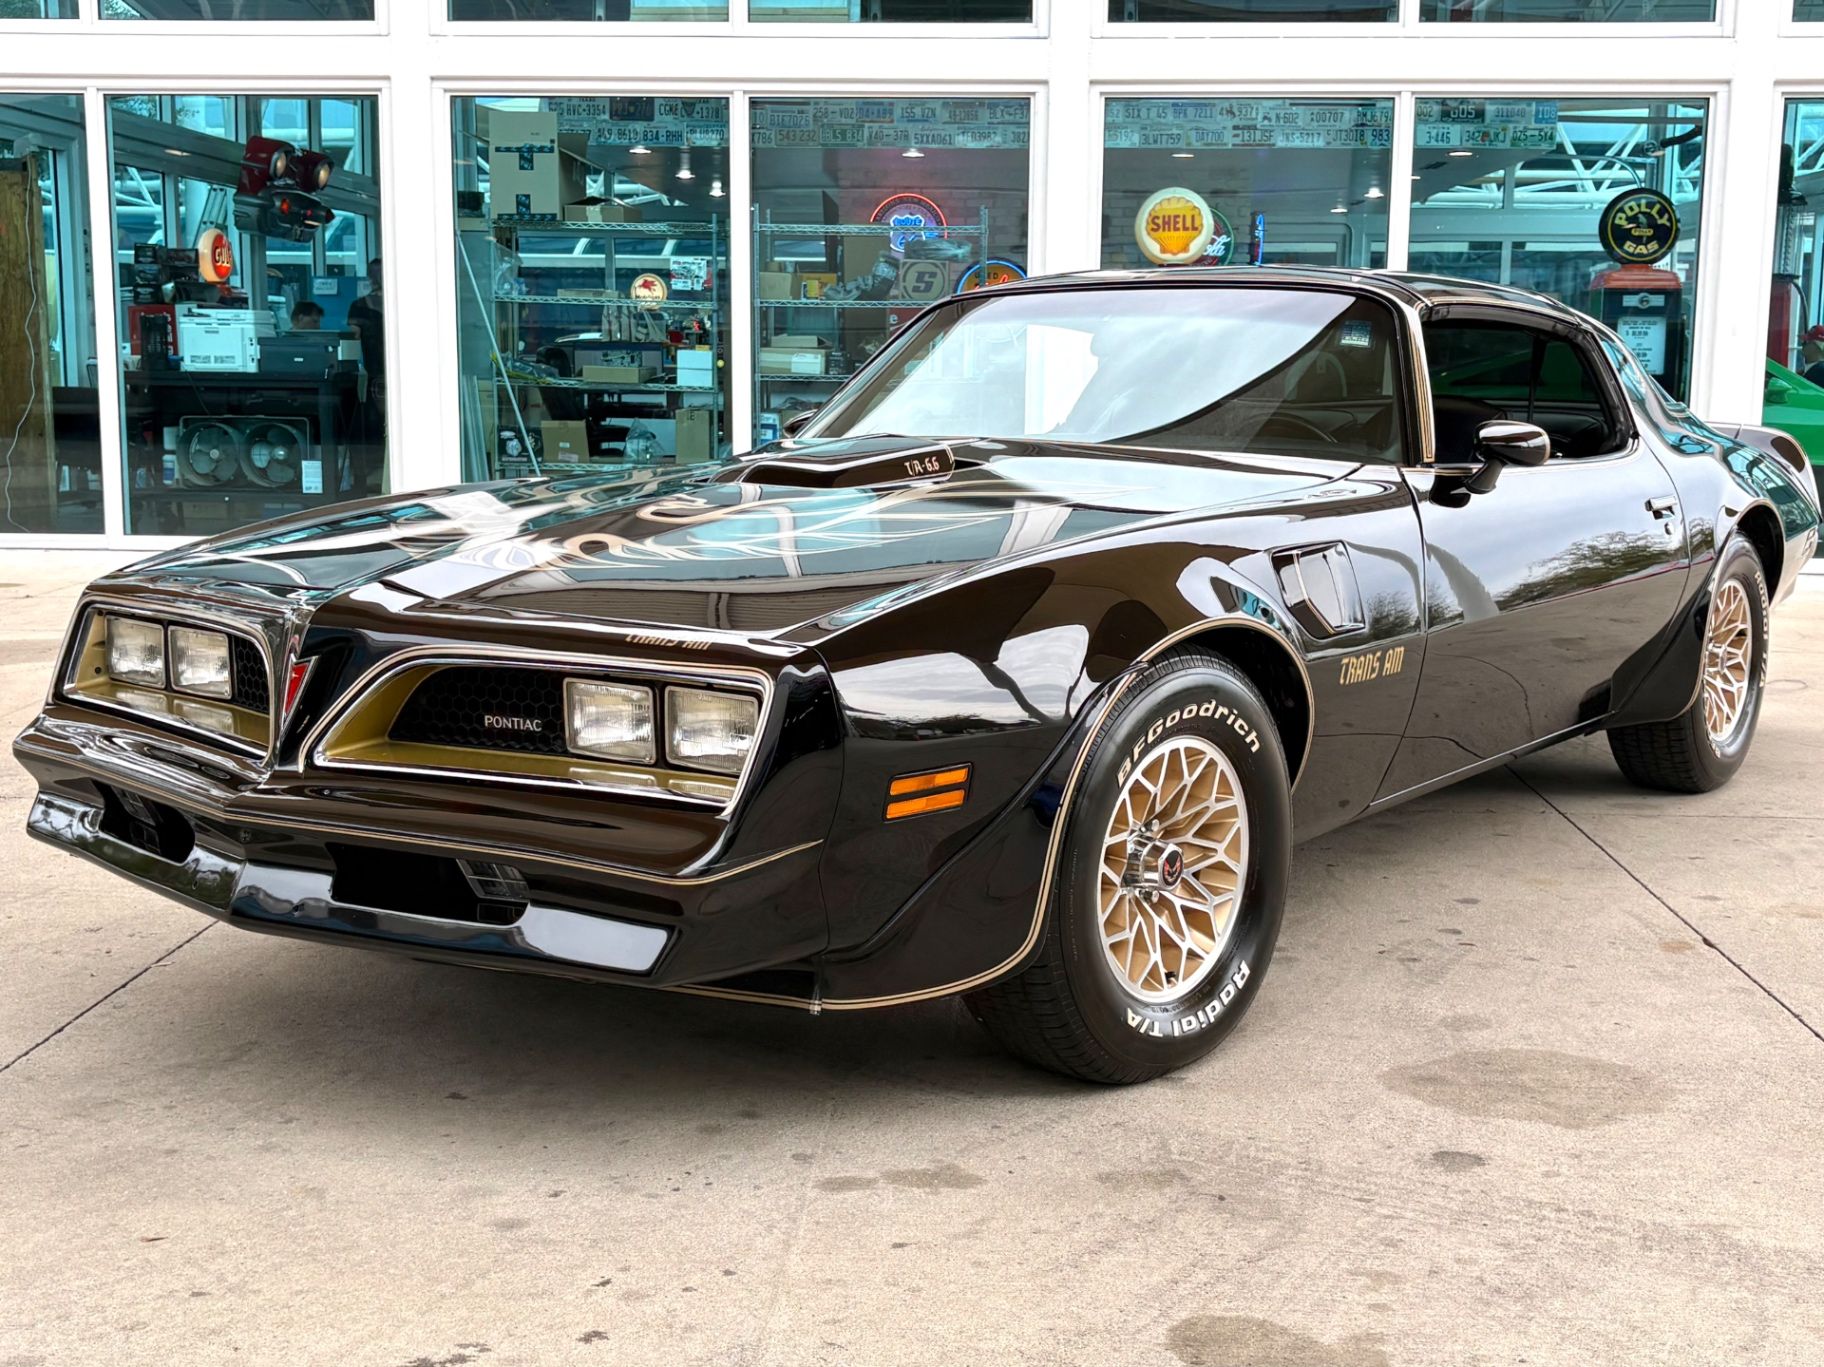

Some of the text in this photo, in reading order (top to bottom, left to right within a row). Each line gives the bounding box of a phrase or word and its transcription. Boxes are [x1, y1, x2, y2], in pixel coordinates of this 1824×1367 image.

[1151, 214, 1200, 232] SHELL
[1614, 198, 1672, 228] POLLY
[1623, 240, 1661, 255] GAS
[1754, 570, 1769, 640] Radial
[1339, 646, 1406, 686] TRANS AM
[484, 714, 543, 732] PONTIAC
[1116, 698, 1262, 789] BFGoodrich
[1126, 959, 1252, 1038] Radial T/A
